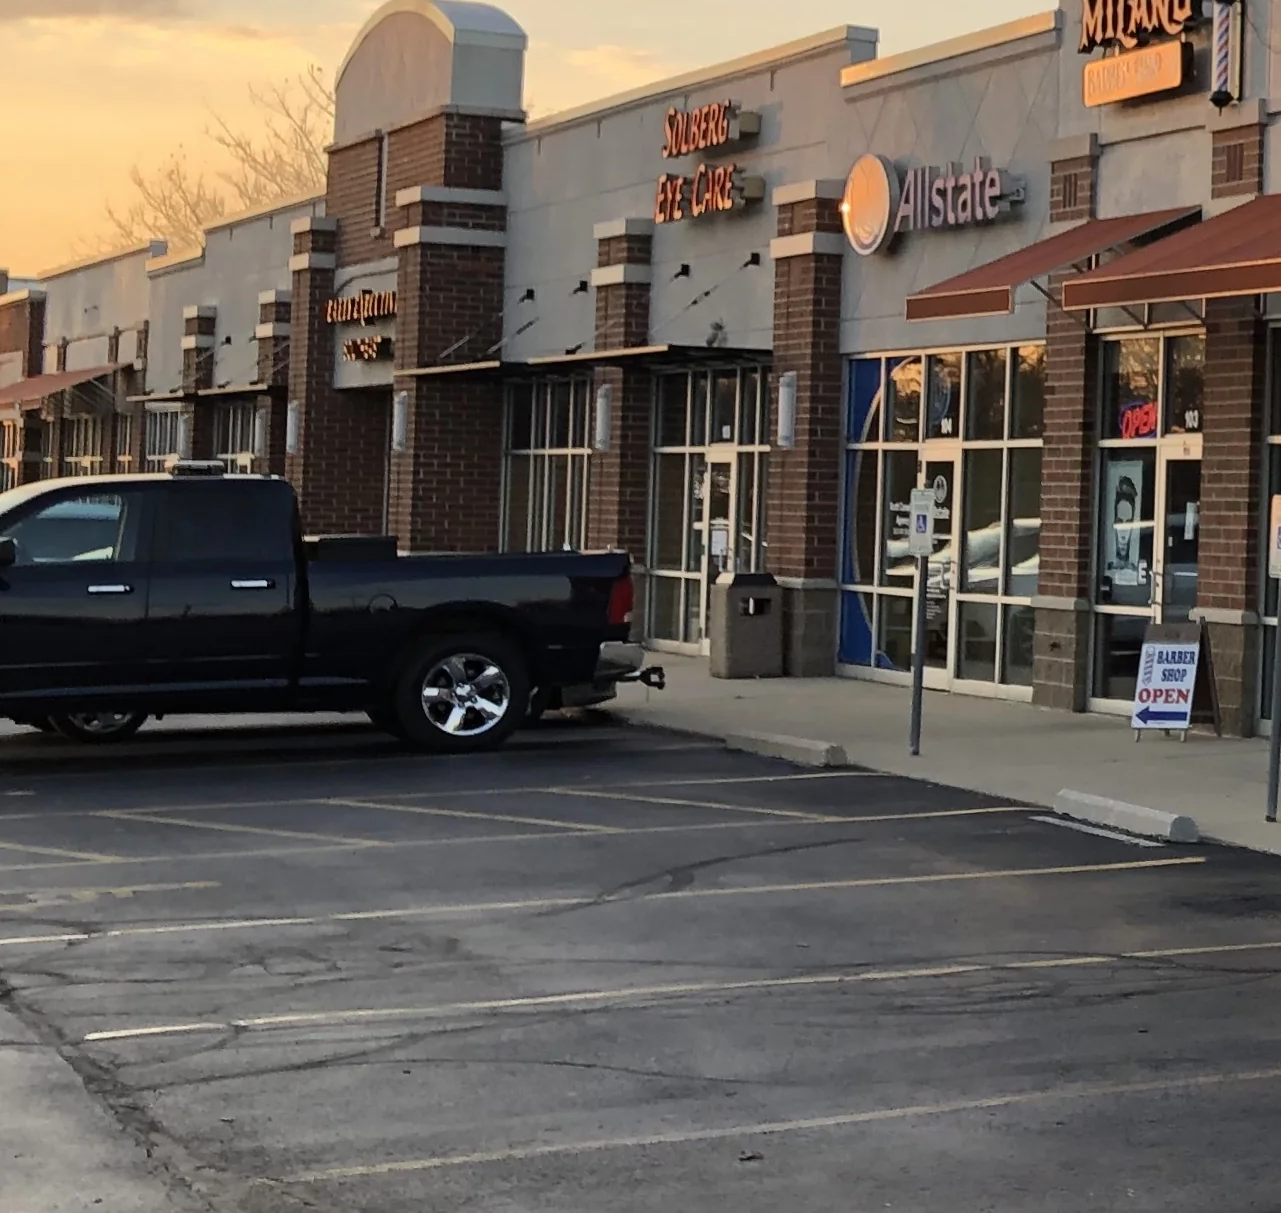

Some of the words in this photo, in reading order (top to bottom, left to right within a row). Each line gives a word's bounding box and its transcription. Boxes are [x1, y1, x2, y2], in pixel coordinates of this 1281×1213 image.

[662, 98, 731, 158] SOLBERG
[655, 174, 684, 224] EYE
[691, 163, 735, 217] CARE
[893, 155, 1001, 233] Allstate
[1157, 650, 1196, 665] BARBER
[1161, 668, 1188, 683] SHOP
[1138, 687, 1191, 704] OPEN
